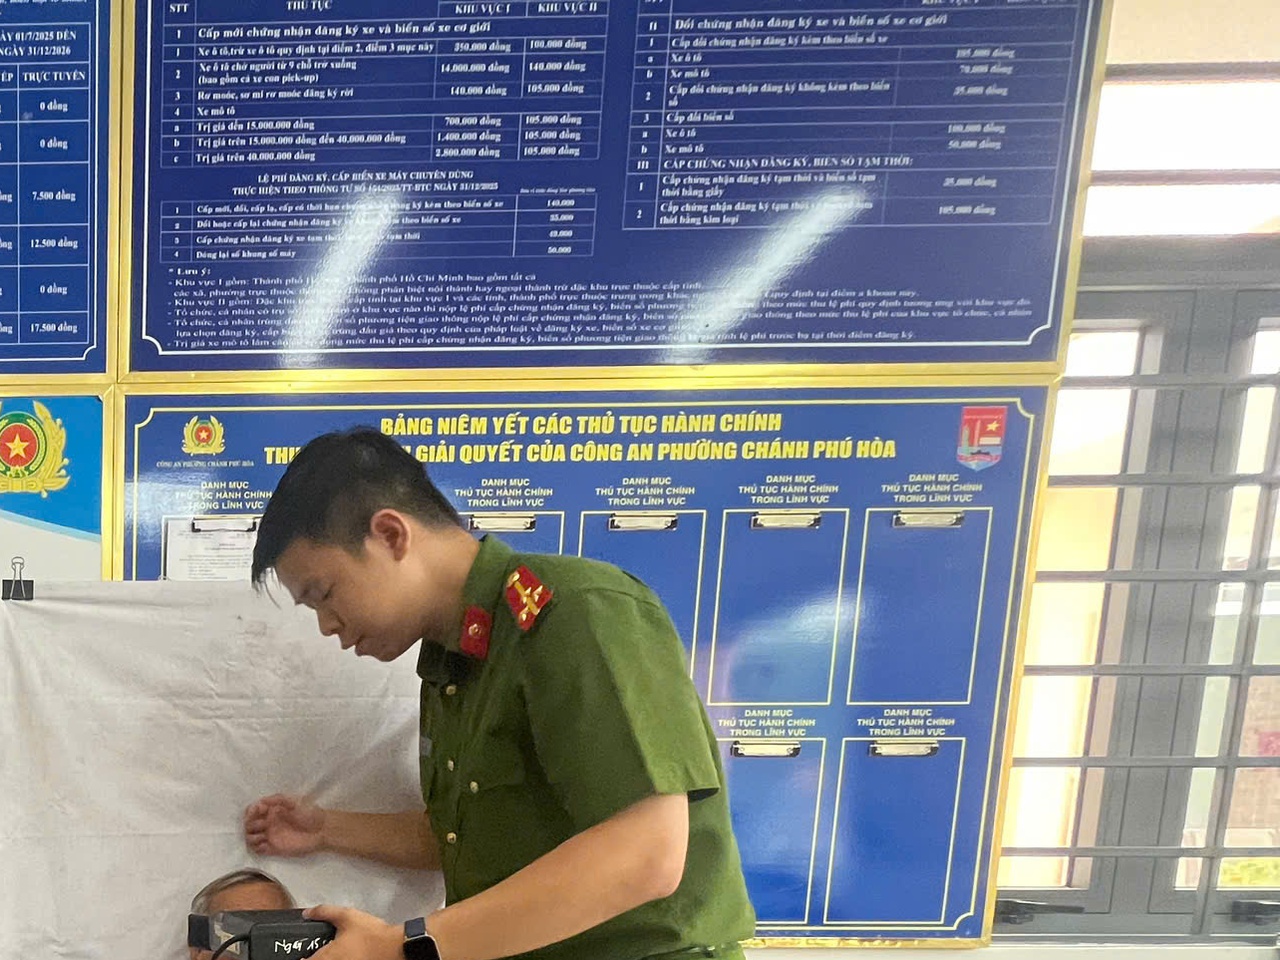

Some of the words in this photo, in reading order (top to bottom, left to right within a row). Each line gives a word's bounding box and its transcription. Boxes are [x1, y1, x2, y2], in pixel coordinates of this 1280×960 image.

[380, 412, 433, 436] BẢNG
[436, 413, 487, 436] NIÊM
[492, 410, 530, 435] YẾT
[532, 411, 572, 434] CÁC
[577, 411, 615, 434] THỦ
[619, 415, 658, 438] TỤC
[661, 412, 716, 433] HÀNH
[719, 410, 782, 432] CHÍNH
[415, 443, 456, 463] GIẢI
[459, 440, 522, 465] QUYẾT
[526, 439, 566, 462] CỦA
[570, 440, 623, 462] CÔNG
[626, 442, 654, 461] AN
[657, 437, 738, 460] PHƯỜNG
[741, 437, 810, 460] CHÁNH
[813, 436, 852, 459] PHÚ
[855, 439, 896, 459] HÒA
[622, 477, 648, 485] DANH
[650, 476, 672, 487] MỤC
[595, 485, 613, 495] THỦ
[613, 487, 634, 497] TỤC
[635, 485, 664, 495] HÀNH
[666, 485, 695, 495] CHÍNH
[608, 497, 641, 506] TRONG
[642, 495, 664, 505] LĨNH
[666, 496, 686, 506] VỰC
